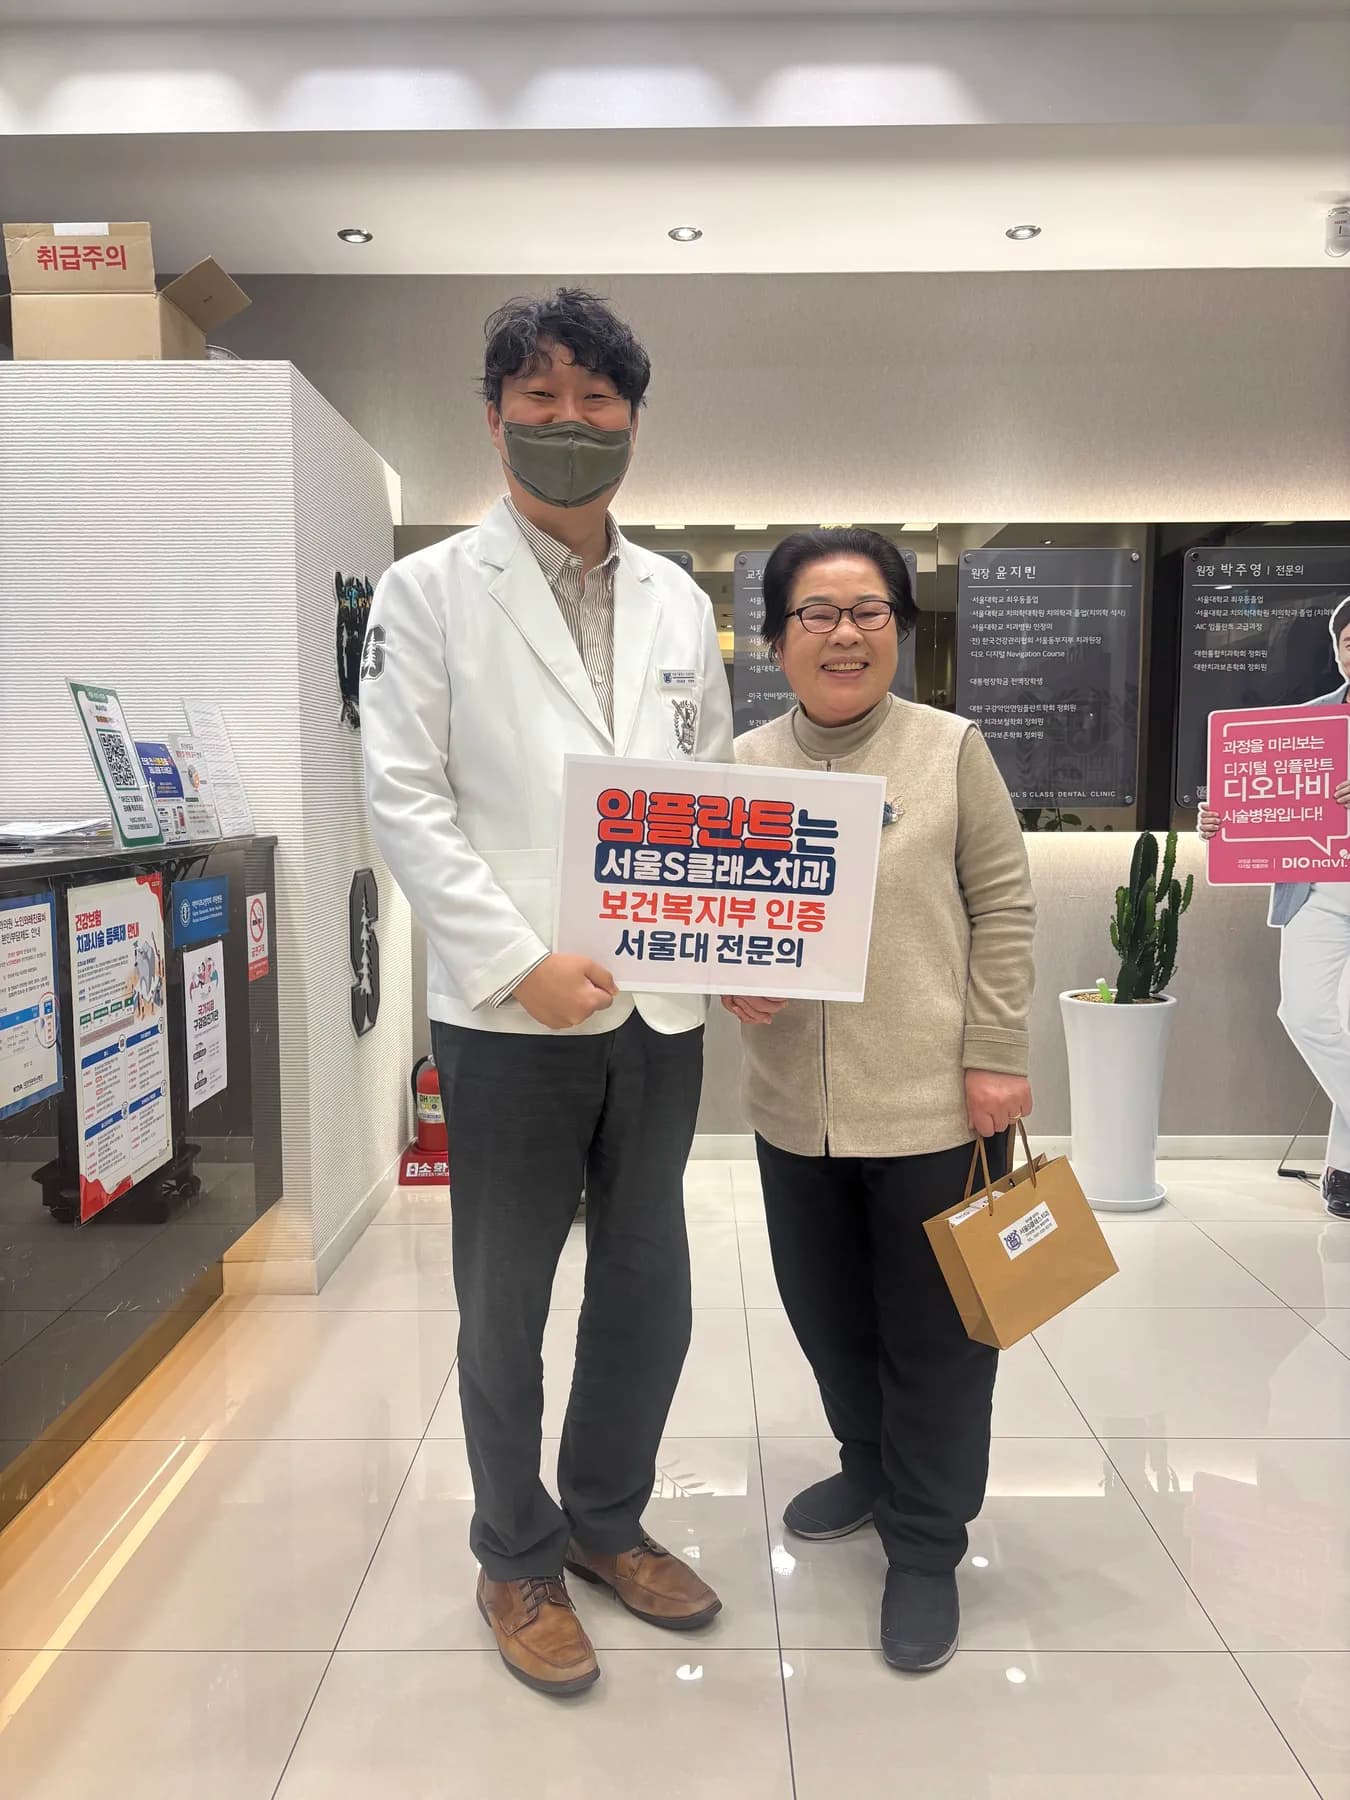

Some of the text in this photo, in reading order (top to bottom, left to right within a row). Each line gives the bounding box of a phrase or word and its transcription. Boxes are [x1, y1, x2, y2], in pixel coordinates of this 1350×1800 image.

[37, 245, 127, 271] 취급주의
[971, 568, 990, 580] 원장
[1196, 563, 1304, 577] 원장 박주영 전문의
[1222, 735, 1326, 755] 과정을 미리보는
[1224, 757, 1335, 777] 디지털 임플란트
[1224, 772, 1330, 803] 디오나비
[597, 788, 839, 856] 임플란트는
[1222, 806, 1324, 824] 시술병원입니다!
[600, 848, 831, 892] 서울S클래스치과
[75, 909, 102, 932] 건강보험
[598, 890, 827, 934] 보건복지부 인증
[76, 930, 105, 955] 치과시술
[615, 929, 805, 968] 서울대 전문의
